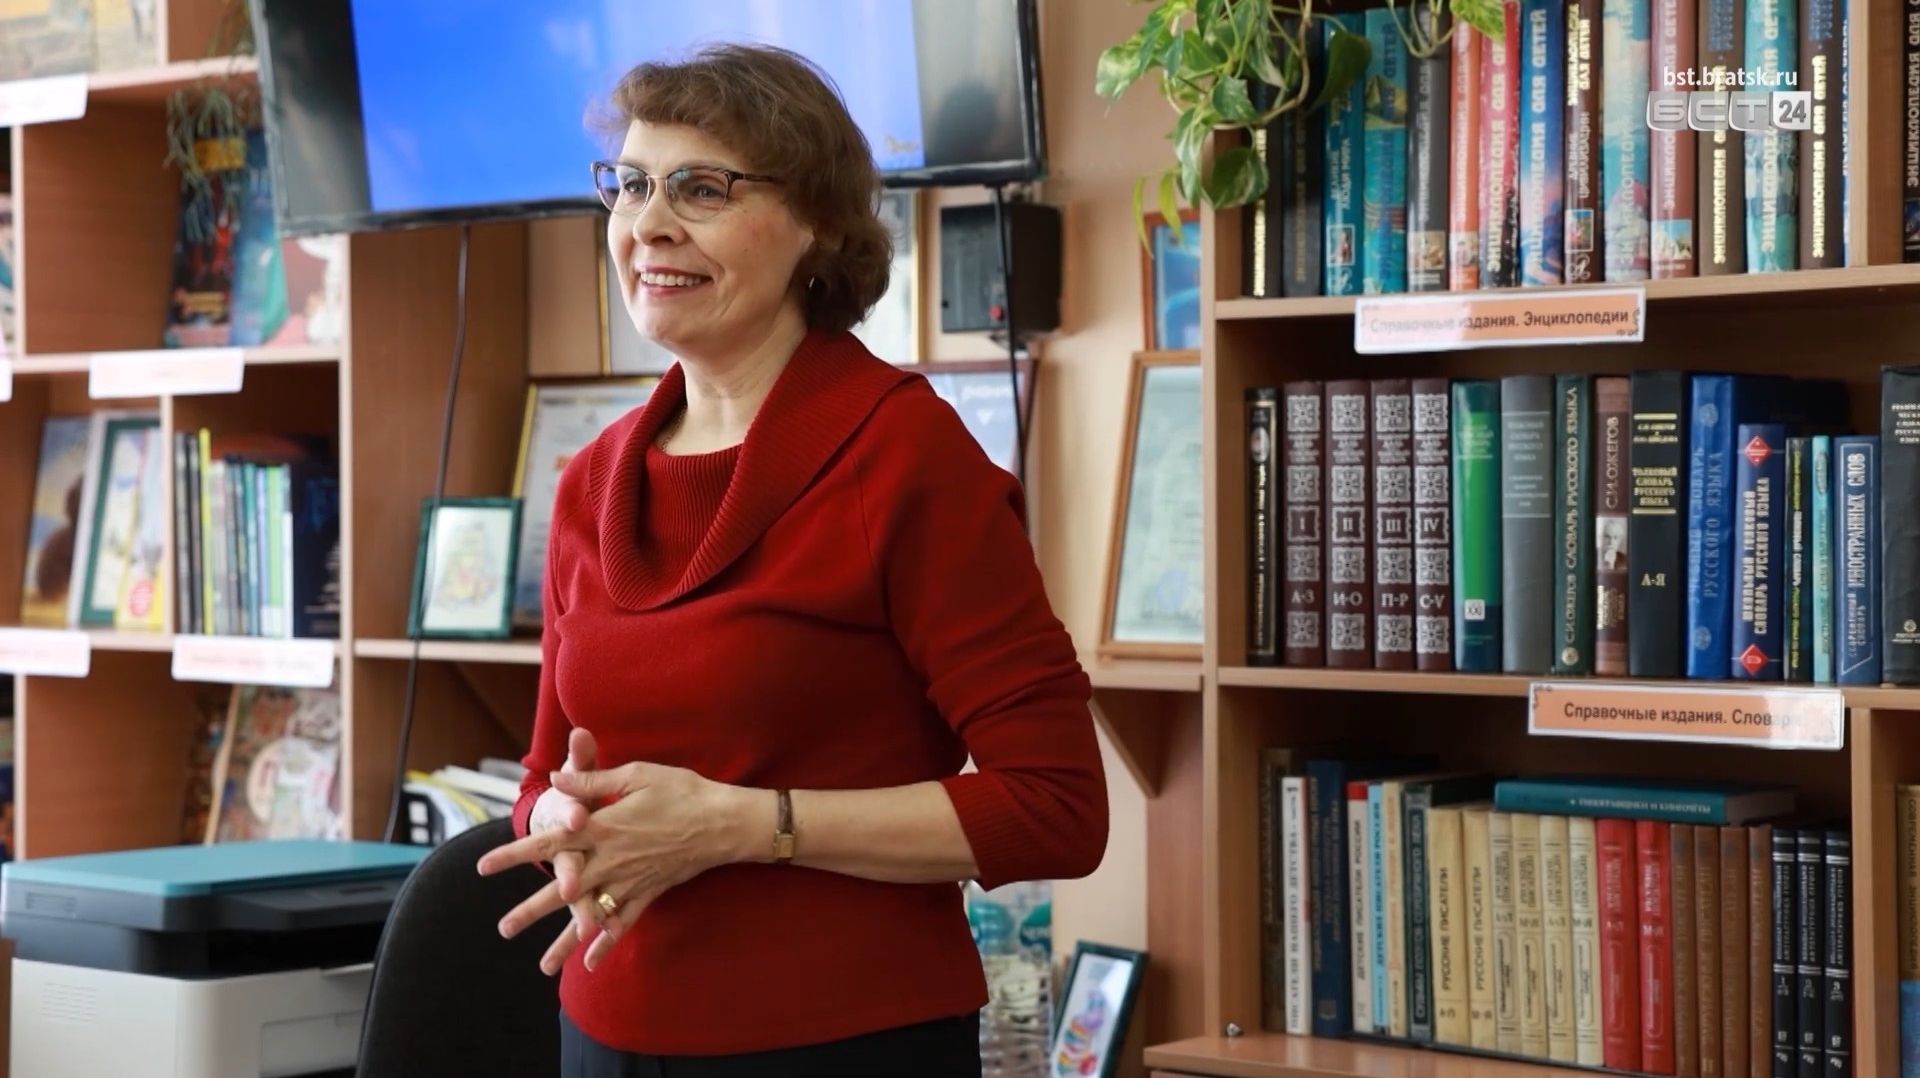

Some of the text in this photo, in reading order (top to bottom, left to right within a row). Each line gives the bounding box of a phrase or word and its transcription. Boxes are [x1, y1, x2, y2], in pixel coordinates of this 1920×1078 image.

[1661, 0, 1676, 45] ДЕТЕ
[1490, 73, 1505, 111] ДЛЯ
[1906, 12, 1920, 188] ЭНЦИКЛОПЕДИЯ ДЛЯ
[1528, 9, 1548, 273] ЭНЦИКЛОПЕДИЯ ДЛЯ ДЕТЕЙ
[1812, 55, 1827, 258] ЭНЦИКЛОПЕДИЯ ДЛЯ ДЕТЕЙ
[1487, 119, 1505, 273] ЭНЦИКЛОПЕДИЯ
[1762, 125, 1778, 252] ЭНЦИКЛОПЕД
[1459, 313, 1519, 331] издания.
[1524, 310, 1628, 328] Энциклопедии
[1566, 386, 1579, 434] ЯЗЫКА
[1566, 436, 1579, 506] РУССКОГО
[1343, 518, 1353, 531] II
[1386, 518, 1401, 532] III
[1424, 518, 1439, 532] IV
[1565, 509, 1579, 569] СЛОВАРЬ
[1703, 452, 1722, 598] РУССКОГО ЯЗЫКА
[1847, 453, 1866, 588] ИНОСТРАННЫХ СЛОВ
[1641, 573, 1666, 586] А-Я
[1742, 490, 1756, 621] ШКОЛЬНЫЙ ТОЛКОВЫЙ
[1754, 477, 1769, 634] СЛОВАРЬ РУССКОГО ЯЗЫКА
[1563, 702, 1657, 721] Справочные
[1661, 709, 1727, 724] издания.
[1355, 868, 1364, 927] ПИСАТЕЛИ
[1439, 867, 1451, 991] РУССКИЕ ПИСАТЕЛИ
[1472, 866, 1485, 991] РУССКИЕ ПИСАТЕЛИ
[1356, 931, 1365, 981] ДЕТСКИЕ
